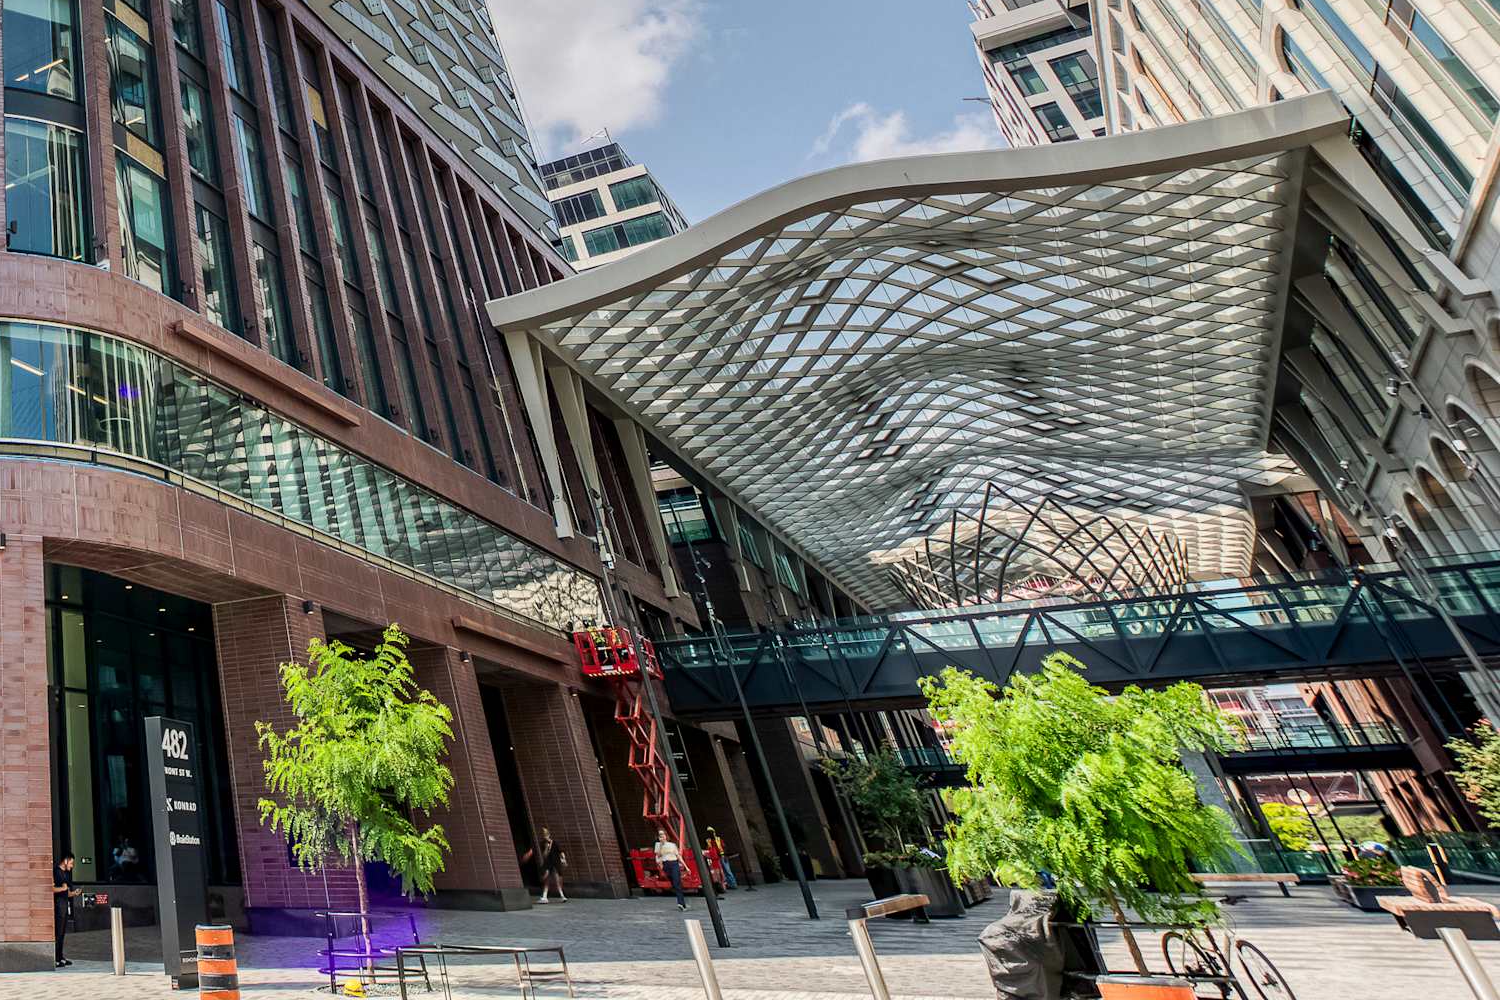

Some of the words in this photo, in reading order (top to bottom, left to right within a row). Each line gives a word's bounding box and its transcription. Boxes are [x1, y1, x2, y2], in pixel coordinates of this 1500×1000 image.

[162, 728, 189, 760] 482
[164, 766, 178, 776] RONT
[174, 800, 197, 811] KONRAD
